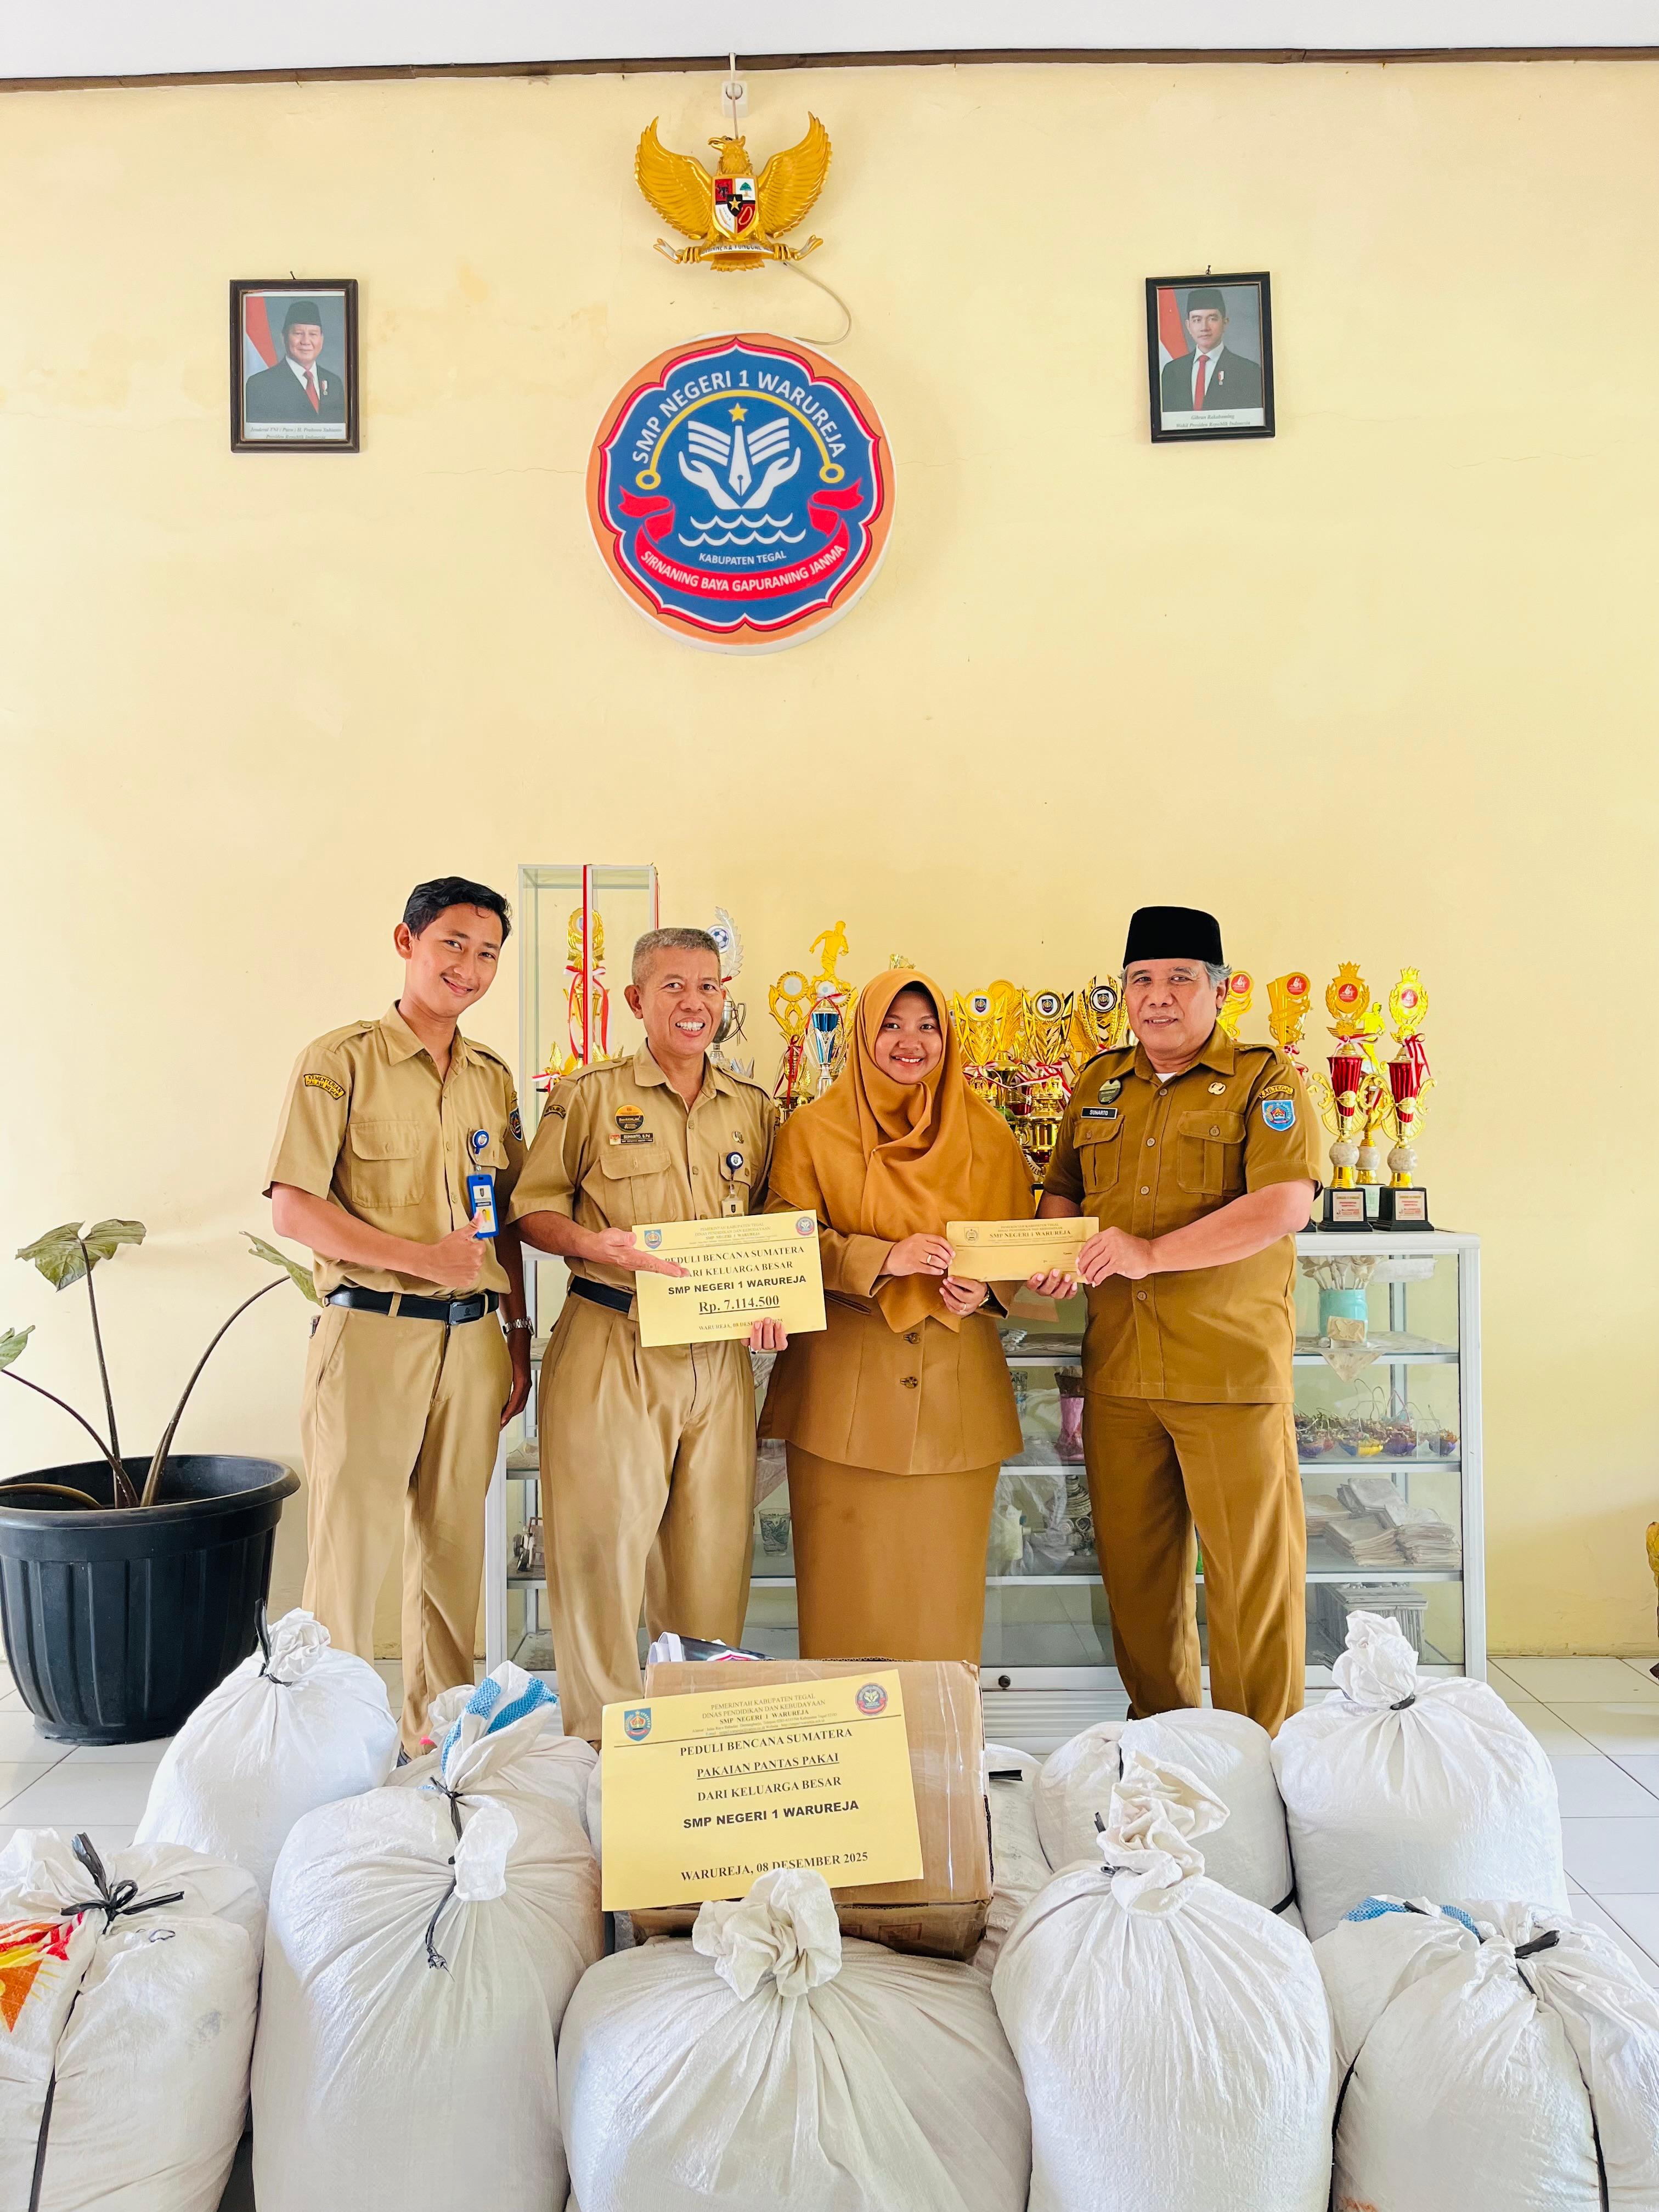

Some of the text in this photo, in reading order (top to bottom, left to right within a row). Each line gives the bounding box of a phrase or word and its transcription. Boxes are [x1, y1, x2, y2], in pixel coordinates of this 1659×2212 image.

[633, 370, 847, 464] SMP NEGERI 1 WARUREJA
[698, 551, 787, 565] KABUPATEN TEGAL
[640, 545, 846, 592] SIRNANING BAYA GAPURANING JANMA
[703, 1251, 749, 1262] BENCANA
[751, 1246, 805, 1257] SUMATERA
[706, 1264, 759, 1276] KELUARGA
[762, 1261, 793, 1271] BESAR
[668, 1285, 691, 1295] SMP
[694, 1282, 734, 1293] NEGERI
[747, 1275, 806, 1288] WARUREJA
[699, 1295, 779, 1313] Rp. 7.114.500
[711, 1700, 752, 1711] PEMERINTAH
[754, 1696, 793, 1706] KABUPATEN
[724, 1706, 763, 1717] PENDIDIKAN
[780, 1700, 826, 1710] KEBUDAYAAN
[771, 1709, 809, 1718] WARUREJA
[680, 1728, 853, 1756] PEDULI BENCANA SUMATERA
[697, 1753, 839, 1778] PAKAIAN PANTAS PAKAI
[698, 1776, 842, 1801] DARI KELUARGA BESAR
[683, 1800, 859, 1829] SMP NEGERI 1 WARUREJA
[681, 1852, 868, 1881] WARUREJA, 08 DESEMBER 2025
